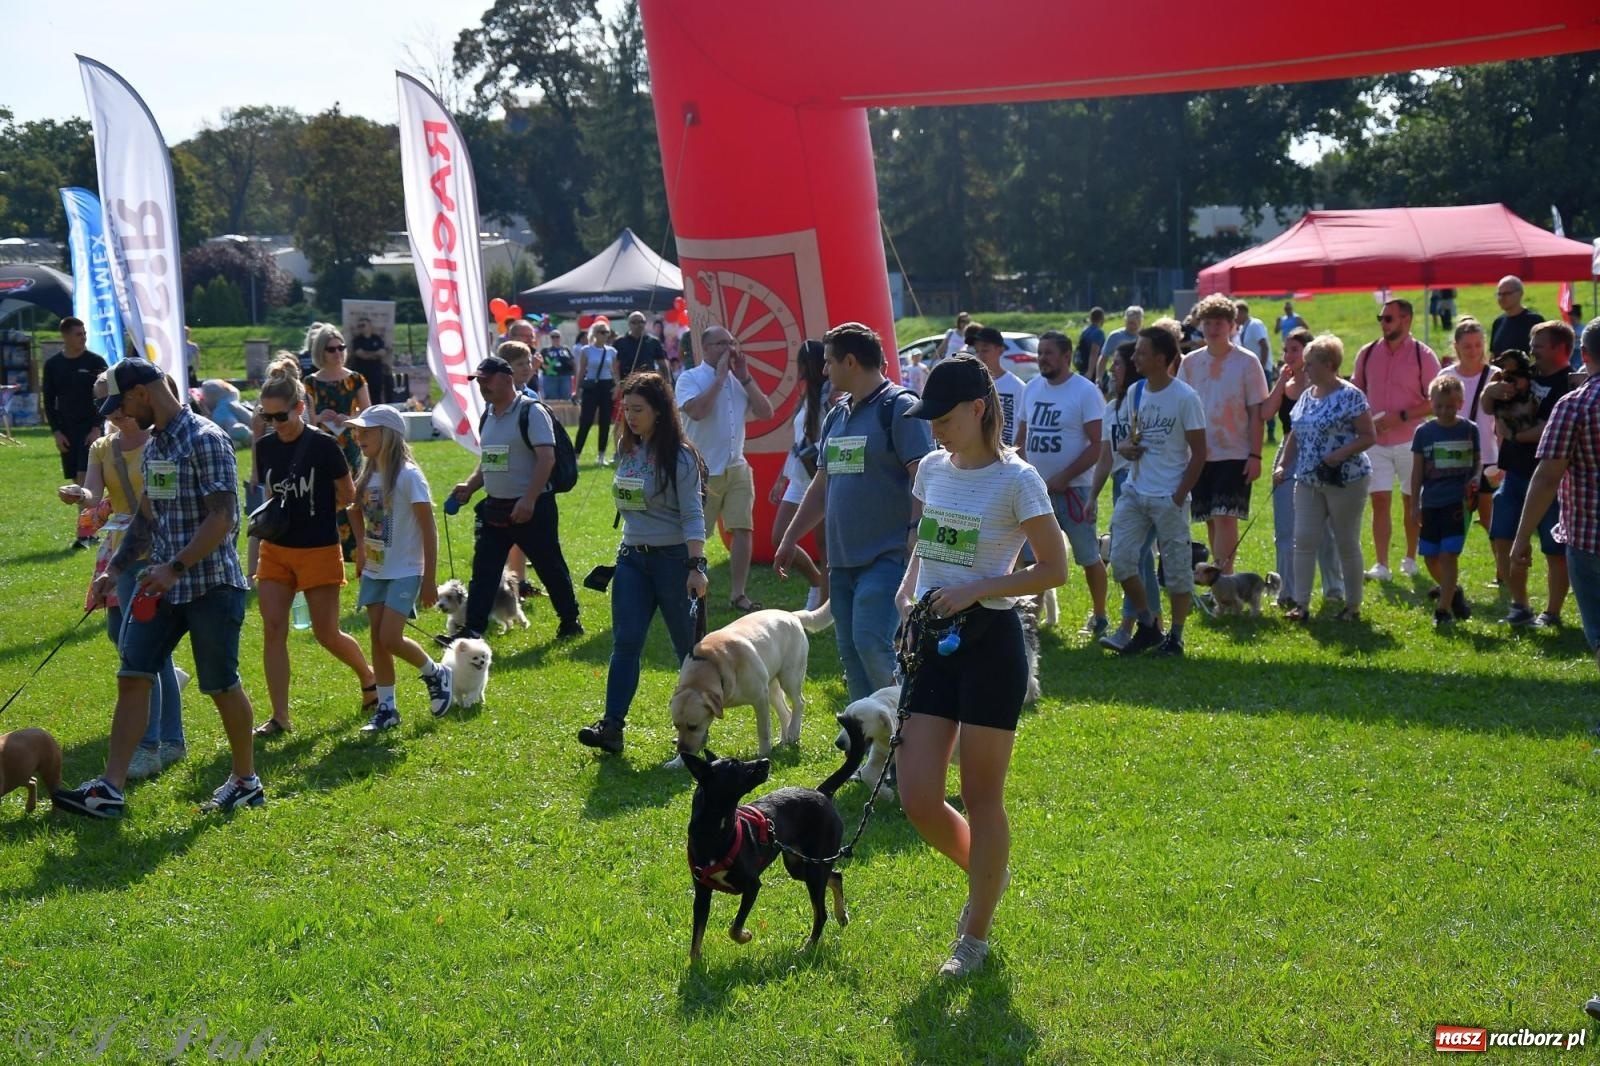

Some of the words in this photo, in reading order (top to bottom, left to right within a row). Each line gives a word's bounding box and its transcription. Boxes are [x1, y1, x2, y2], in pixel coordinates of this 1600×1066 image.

[1031, 401, 1062, 426] The
[839, 448, 852, 461] 55
[154, 473, 165, 487] 15
[618, 488, 631, 500] 56
[937, 526, 958, 545] 83
